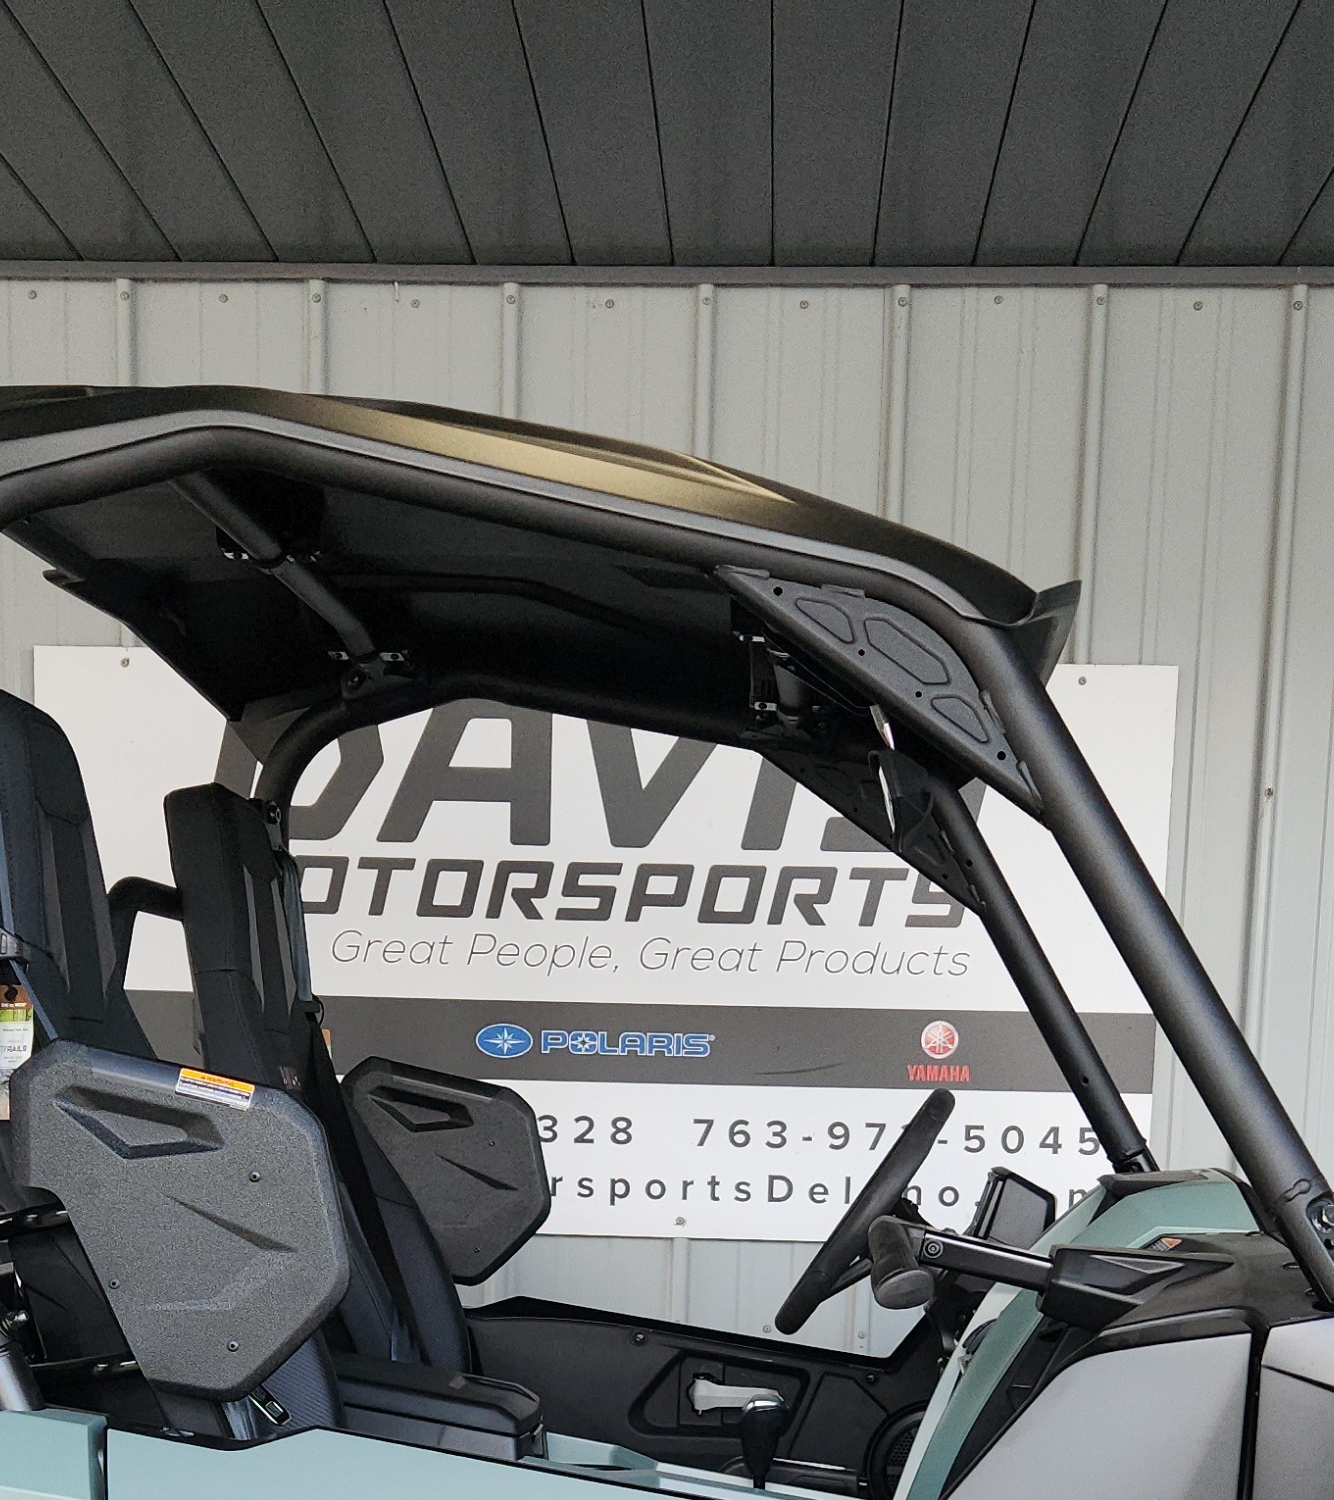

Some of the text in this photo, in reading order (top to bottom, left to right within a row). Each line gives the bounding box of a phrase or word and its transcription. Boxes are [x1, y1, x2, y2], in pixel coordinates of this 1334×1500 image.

[294, 855, 966, 928] OTORSPORTS
[331, 929, 971, 977] Great People, Great Products
[540, 1029, 711, 1059] POLARIS
[907, 1064, 971, 1083] YAMAHA
[537, 1115, 1101, 1156] 328 763-97-5045
